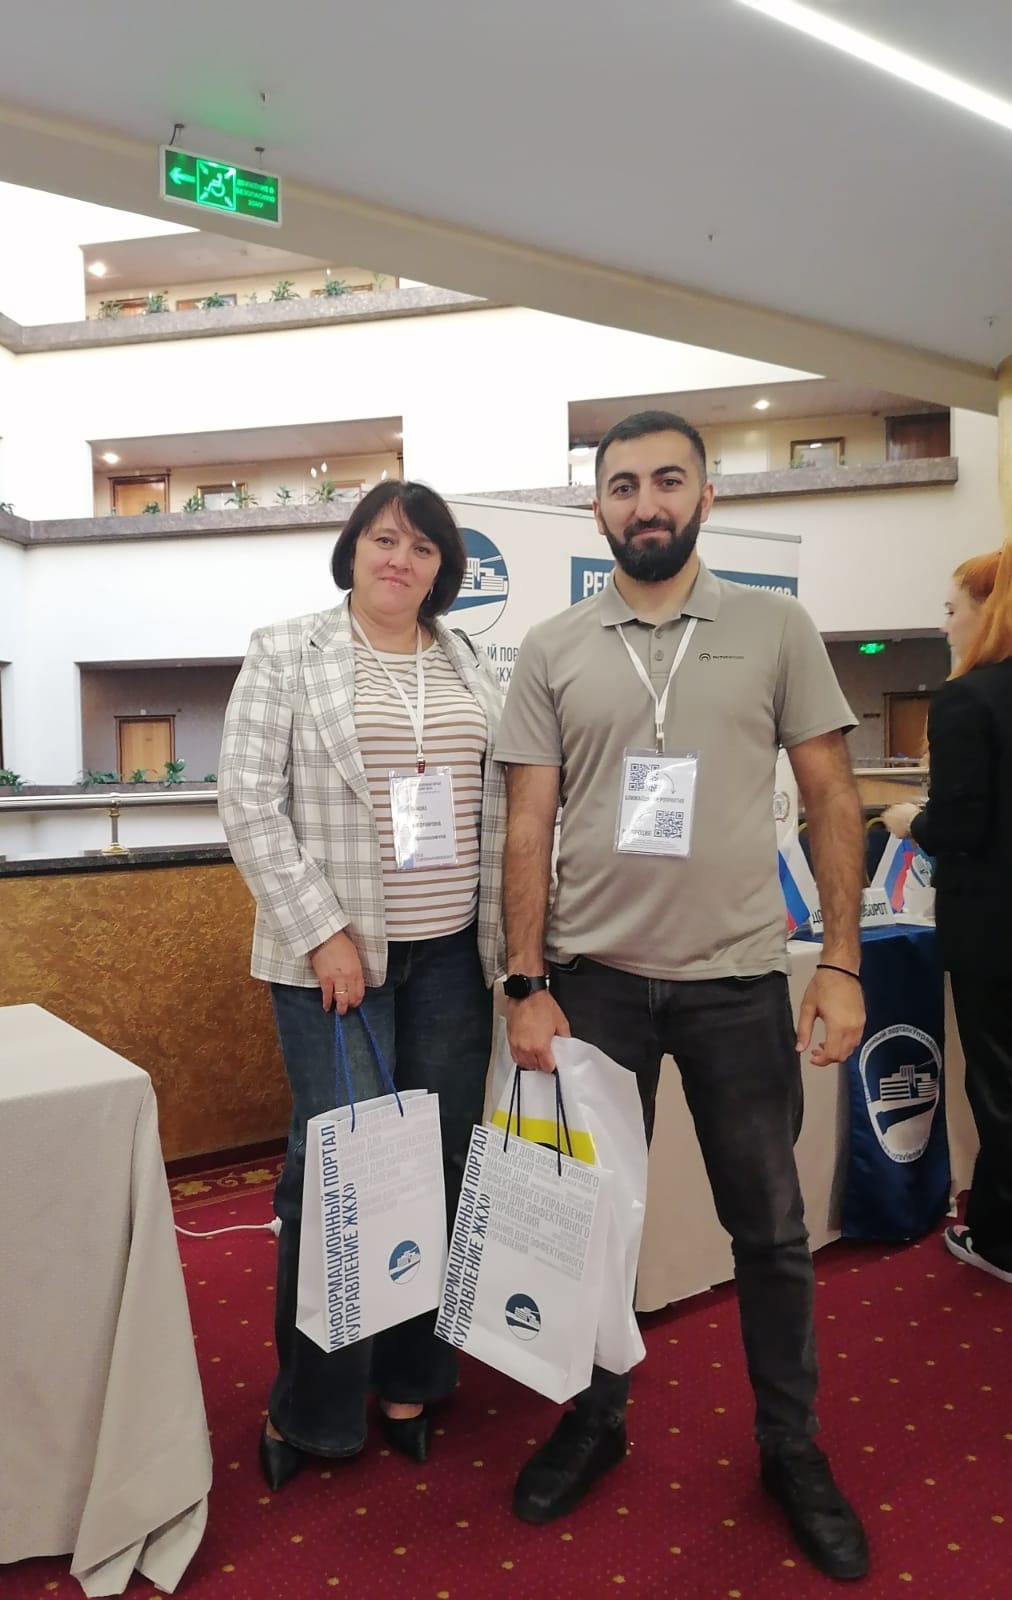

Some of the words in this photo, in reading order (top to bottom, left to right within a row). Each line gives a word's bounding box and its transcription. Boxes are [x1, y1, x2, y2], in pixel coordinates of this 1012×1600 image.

[321, 1124, 339, 1187] ПОРТАЛ
[465, 1126, 488, 1186] ПОРТАЛ
[321, 1189, 345, 1350] ИНФОРМАЦИОННЫЙ
